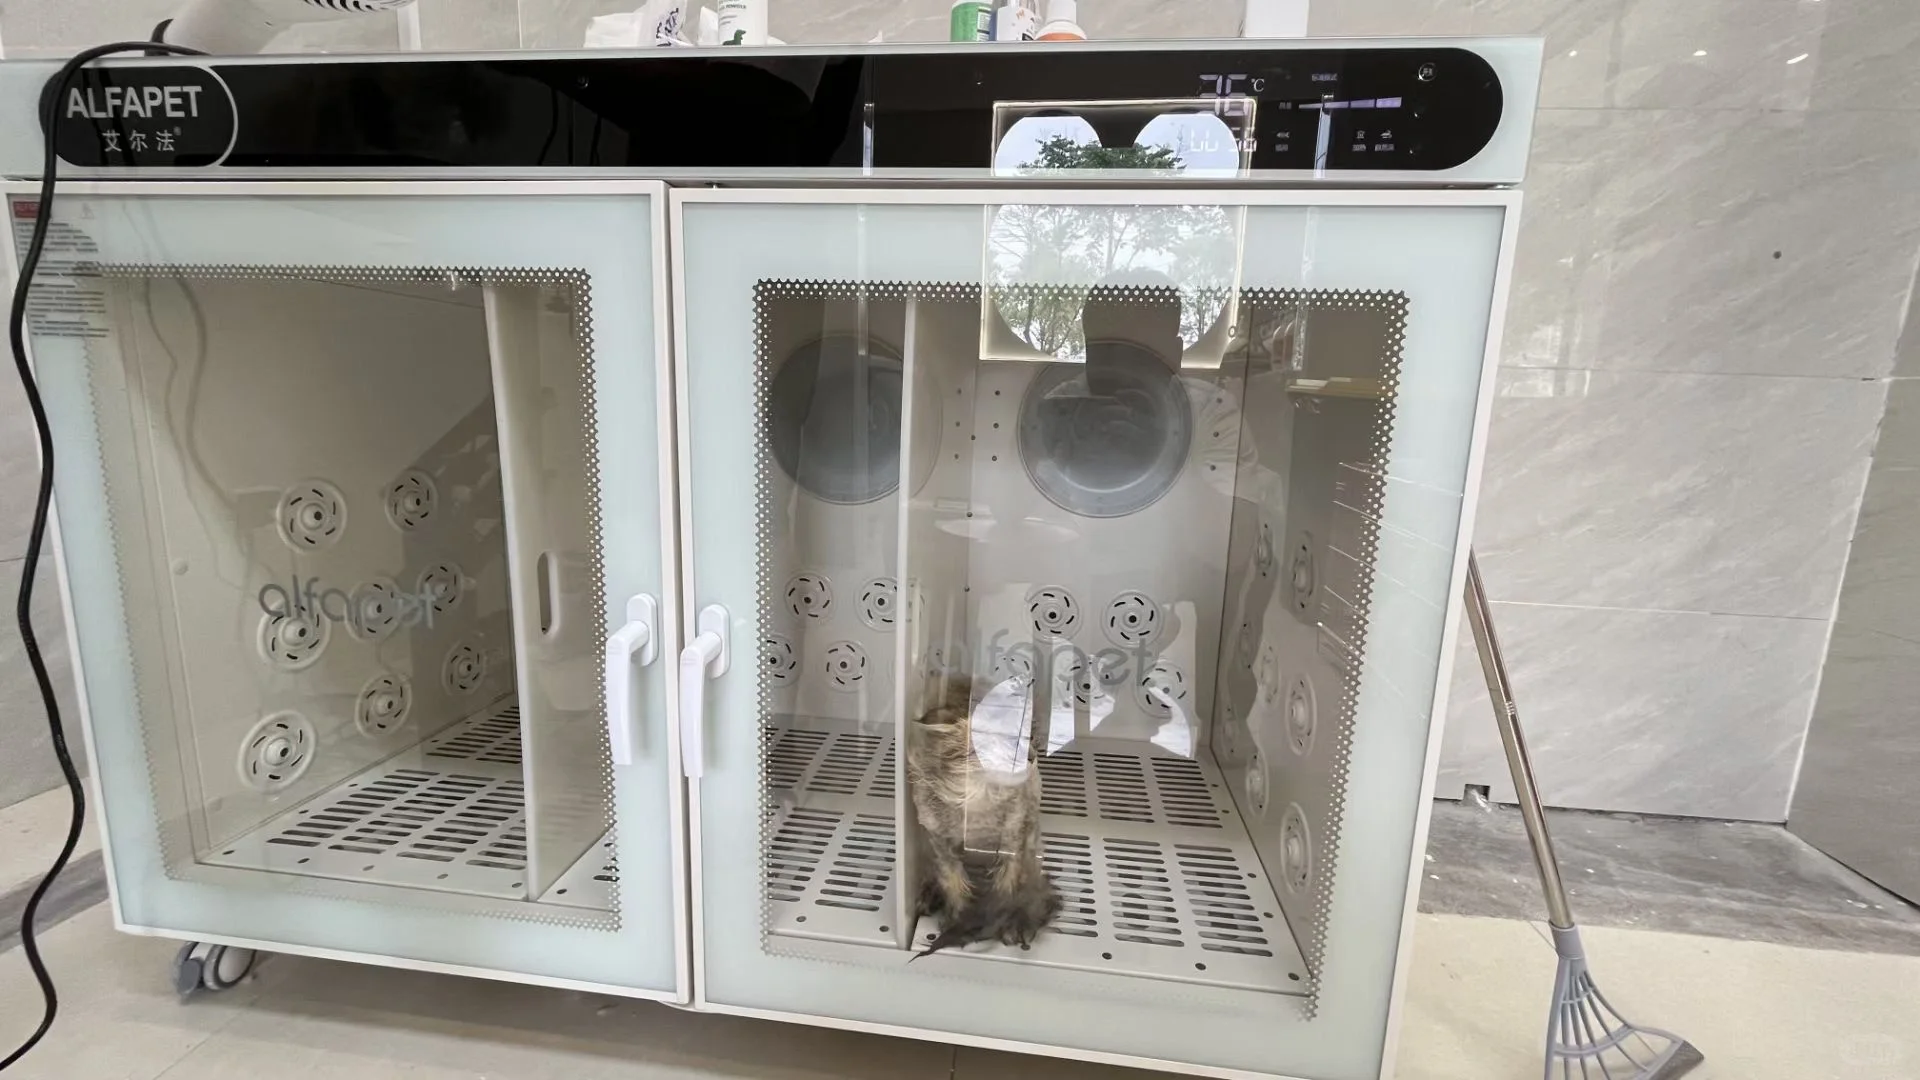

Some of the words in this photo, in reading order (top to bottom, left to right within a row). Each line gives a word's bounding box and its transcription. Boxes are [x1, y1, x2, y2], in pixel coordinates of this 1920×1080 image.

[66, 86, 203, 119] ALFAPET
[102, 129, 176, 152] 艾尔法
